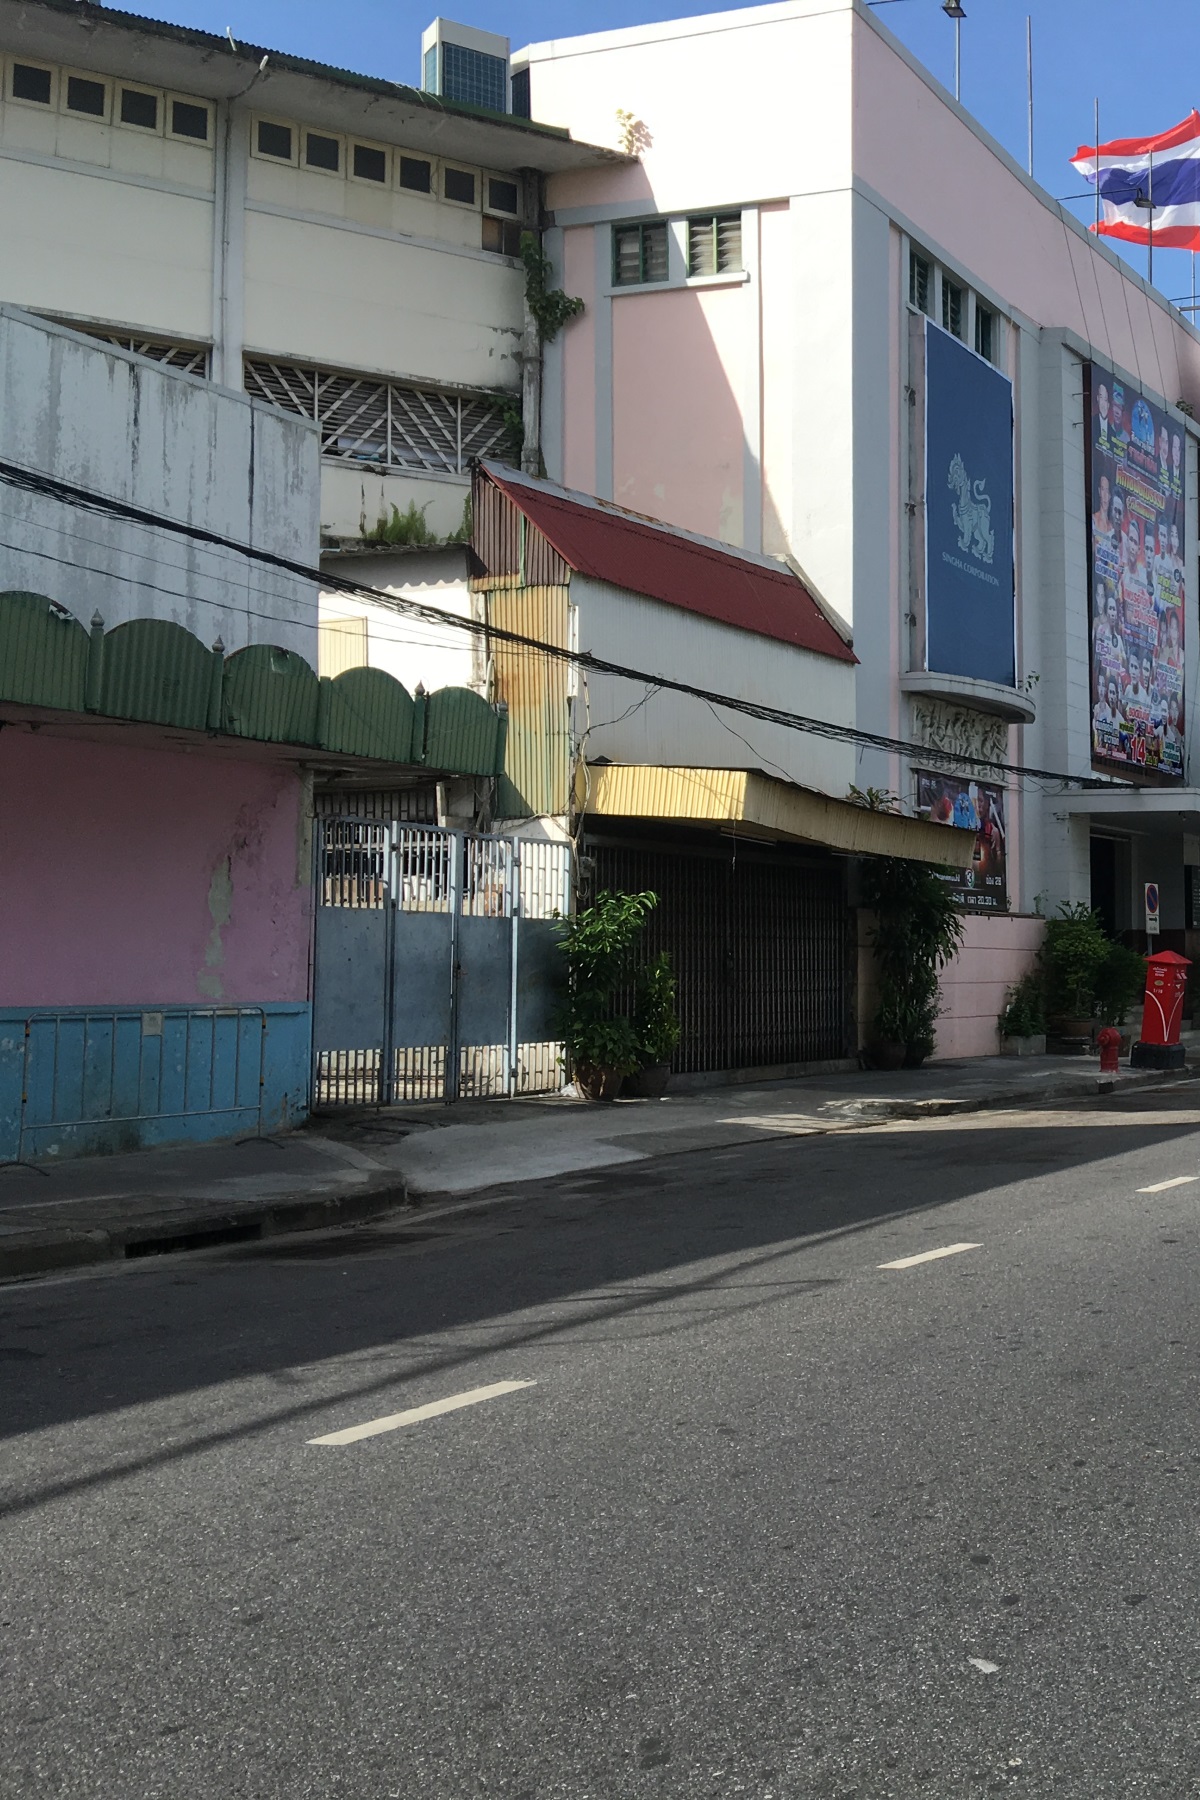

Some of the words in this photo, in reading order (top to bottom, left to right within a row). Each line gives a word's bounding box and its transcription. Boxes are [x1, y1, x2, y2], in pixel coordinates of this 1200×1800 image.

[942, 551, 963, 569] SINGHA
[963, 562, 1000, 587] CORPORATION
[1131, 734, 1147, 766] 14
